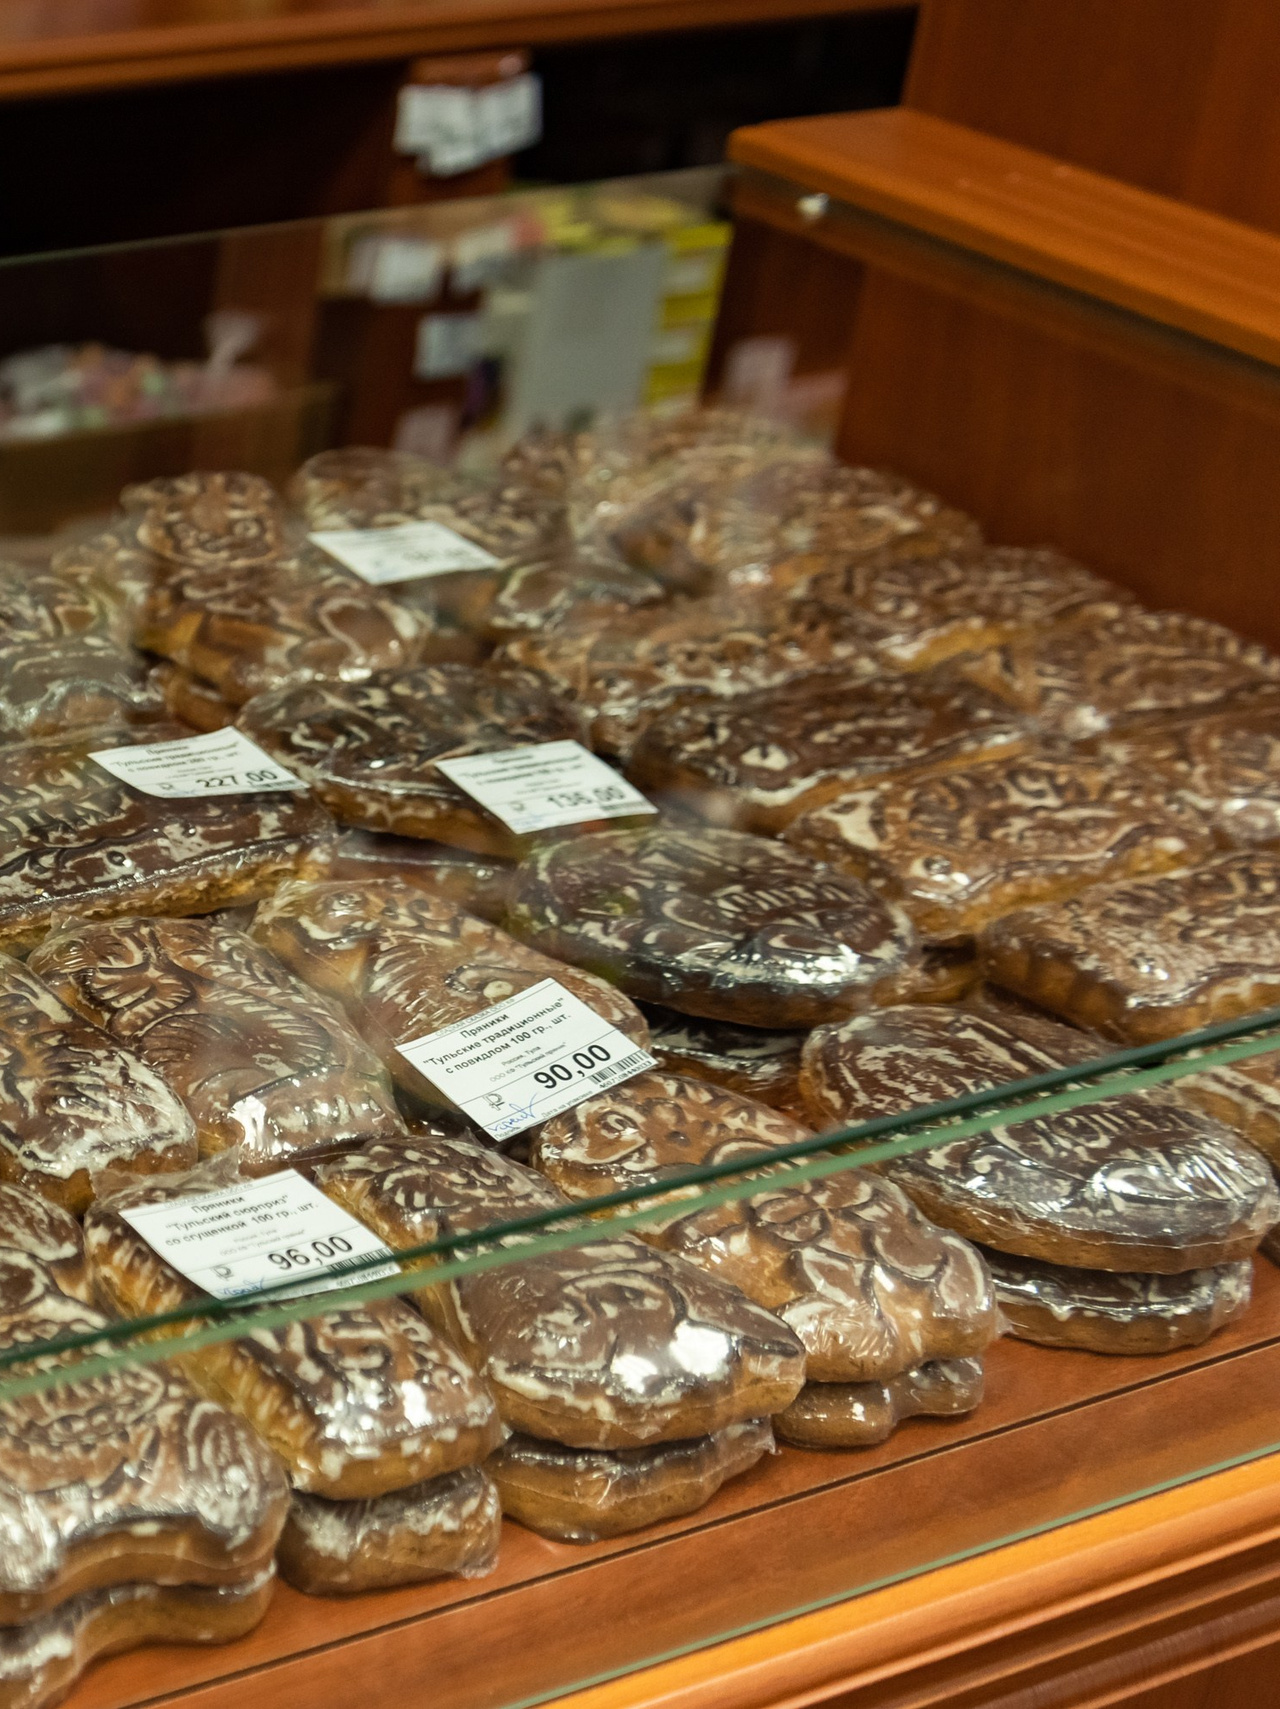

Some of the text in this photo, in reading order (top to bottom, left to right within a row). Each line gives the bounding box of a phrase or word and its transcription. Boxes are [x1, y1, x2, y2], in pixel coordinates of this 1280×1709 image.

[196, 769, 279, 788] 227,00
[422, 997, 563, 1065] "Тульские традиционные"
[453, 1042, 511, 1070] повидлом
[509, 1031, 531, 1044] 100
[550, 1013, 570, 1025] шт.
[459, 1013, 509, 1038] Пряники
[523, 1045, 541, 1055] Тула
[533, 1044, 610, 1089] 90,00
[166, 1194, 287, 1230] "Тульский сюрприз"
[182, 1220, 247, 1241] сгущенкой
[250, 1213, 273, 1223] 100
[296, 1202, 317, 1212] шт.
[190, 1196, 244, 1212] Пряники
[267, 1235, 353, 1272] 96,00
